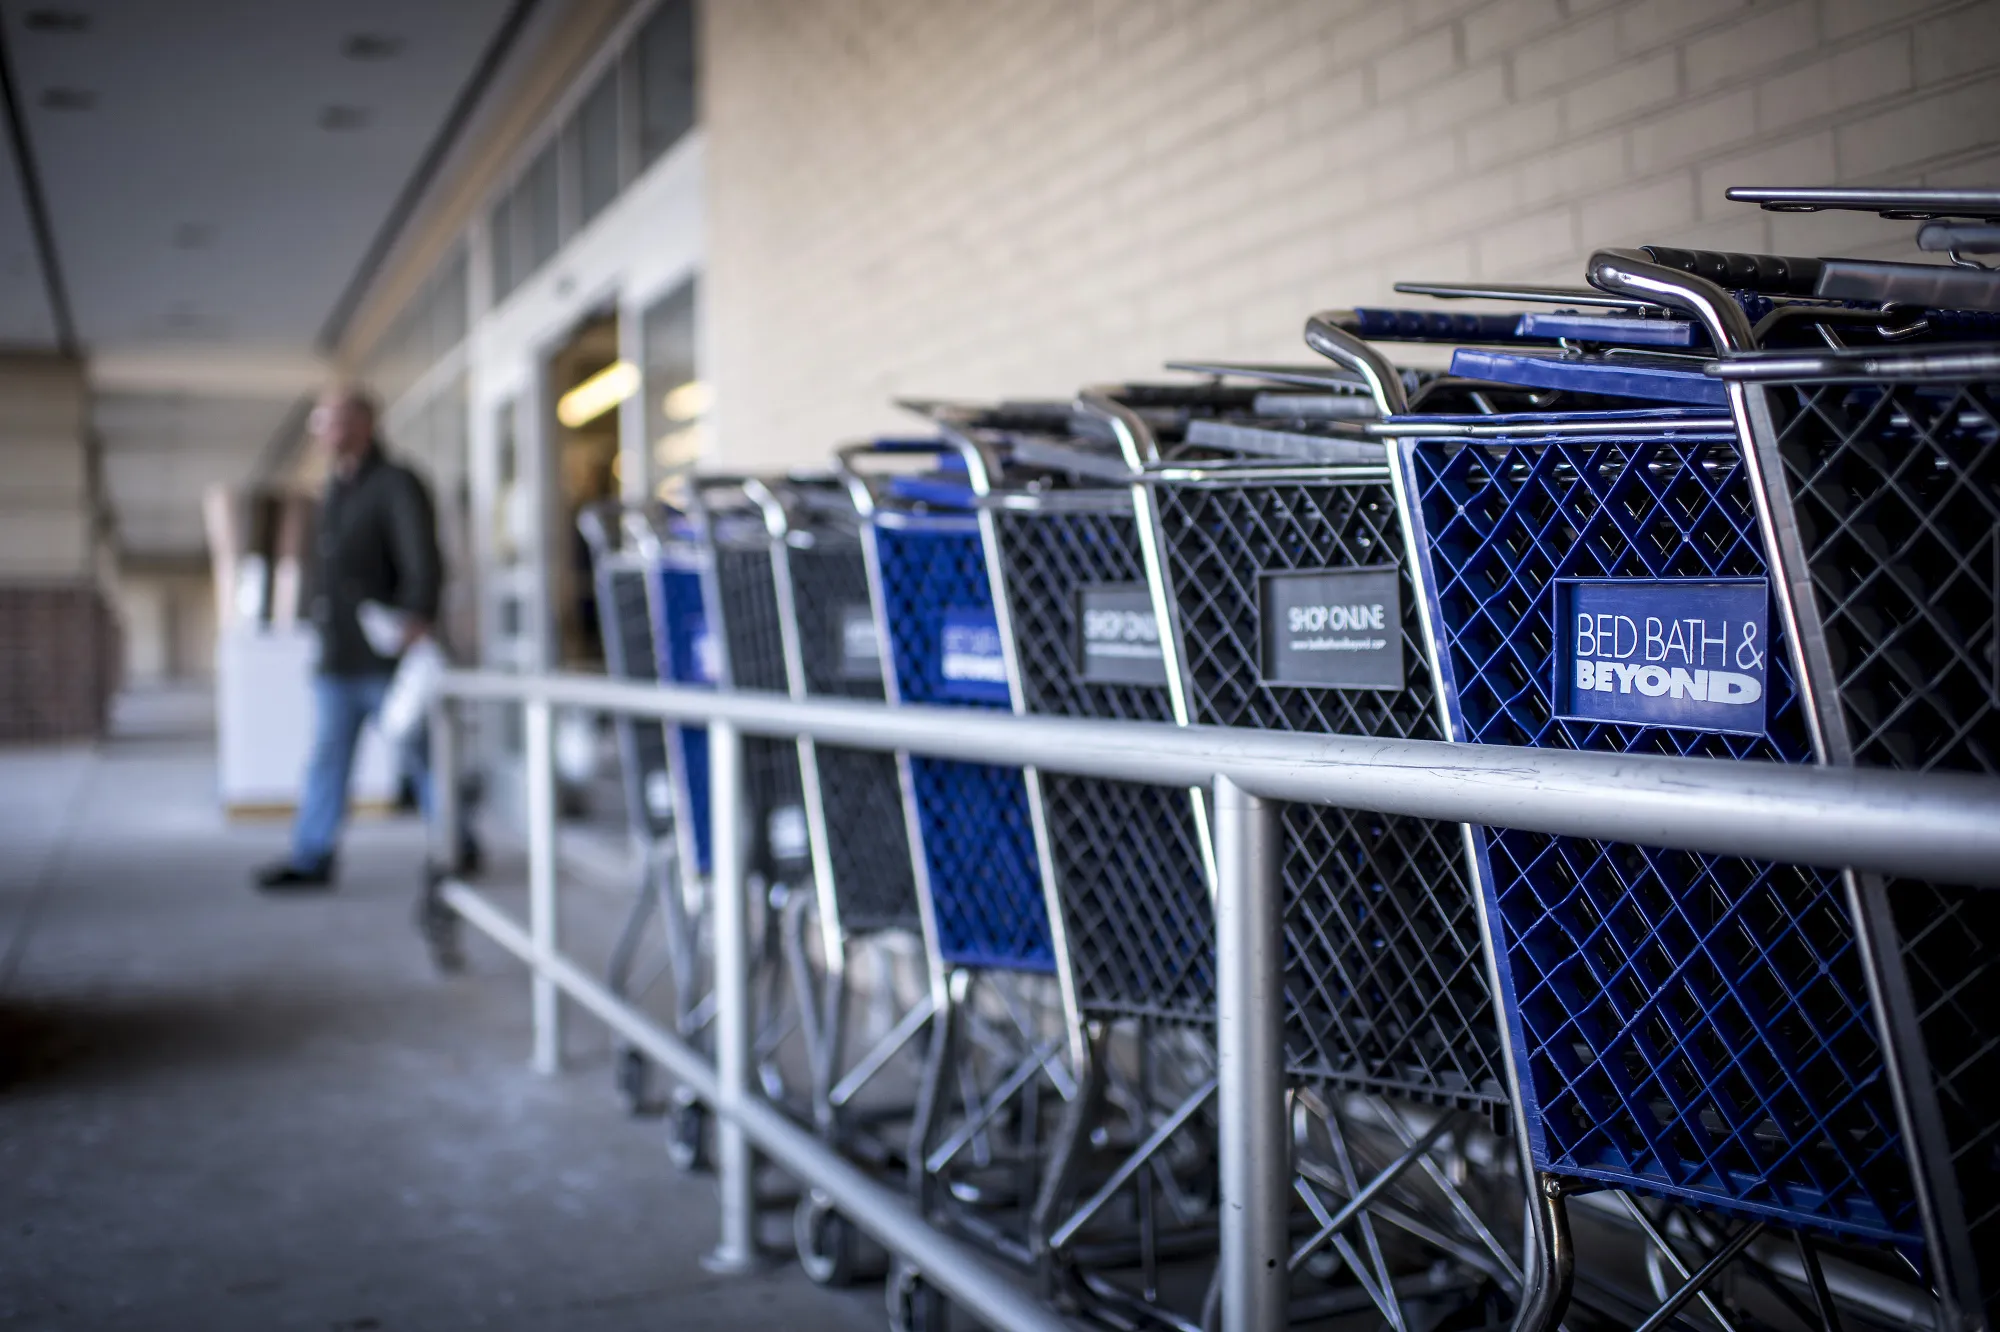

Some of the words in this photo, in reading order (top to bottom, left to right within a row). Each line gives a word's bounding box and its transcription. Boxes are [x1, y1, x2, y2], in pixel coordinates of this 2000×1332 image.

[1288, 605, 1328, 632] SHOP
[1329, 604, 1385, 631] ONLINE
[1576, 612, 1638, 659] BED
[1645, 616, 1727, 667] BATH
[1735, 621, 1764, 671] &
[1576, 659, 1762, 705] BEYOND
